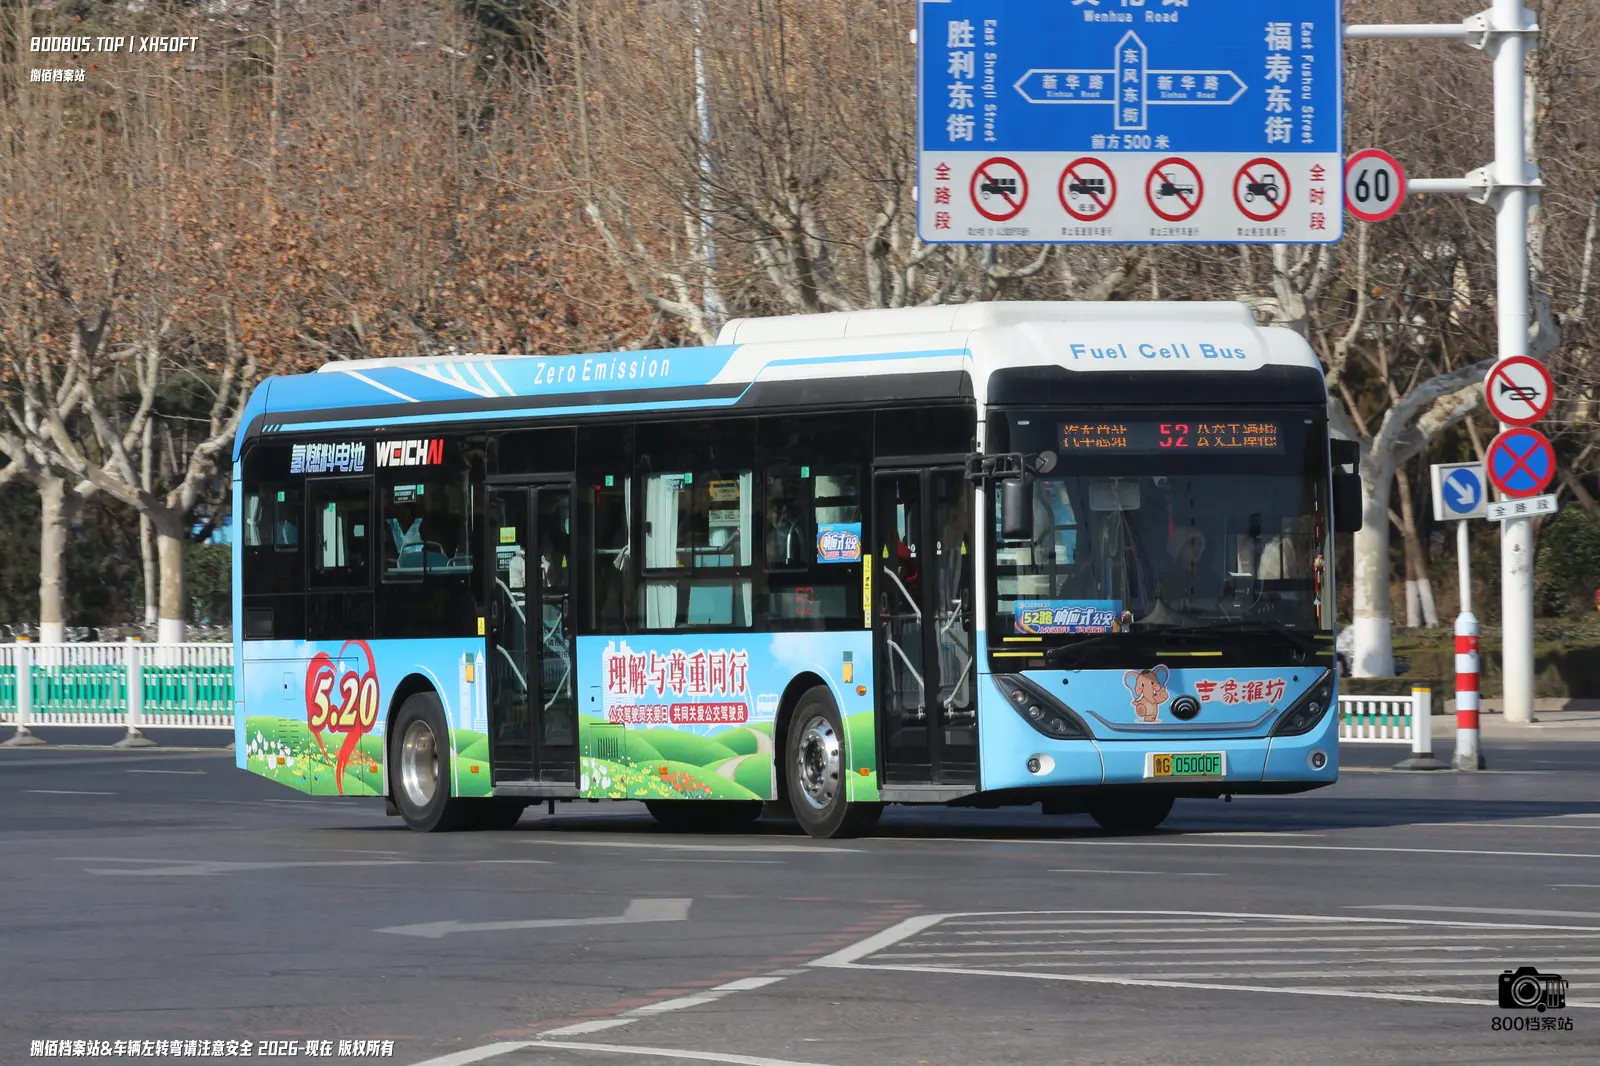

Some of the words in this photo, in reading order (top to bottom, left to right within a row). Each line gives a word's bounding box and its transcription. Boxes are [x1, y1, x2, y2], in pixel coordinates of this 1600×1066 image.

[1083, 10, 1133, 22] Wenhua
[1145, 10, 1179, 22] Road
[983, 19, 998, 46] East
[1300, 21, 1315, 49] East
[945, 19, 976, 142] 胜利东街
[1042, 74, 1104, 90] 新华路
[1122, 48, 1139, 122] 东风东街
[1157, 75, 1220, 91] 新华路
[1264, 21, 1293, 144] 福寿东街
[1300, 54, 1315, 100] Fushou
[983, 104, 998, 142] Street
[1300, 105, 1315, 144] Street
[1355, 168, 1389, 203] 60
[1069, 343, 1128, 360] Fuel
[1138, 343, 1191, 360] Cell
[1199, 343, 1247, 360] Bus
[534, 361, 576, 385] Zero
[581, 355, 671, 381] Emission
[1159, 423, 1189, 447] 52
[290, 441, 367, 474] 氢燃料电池
[376, 438, 445, 468] WEICHAI
[607, 650, 748, 696] 理解与尊重同行
[311, 676, 378, 727] 5.20
[608, 704, 669, 724] 公交驾驶员关爱日
[673, 704, 745, 723] 共同关爱公交驾驶员
